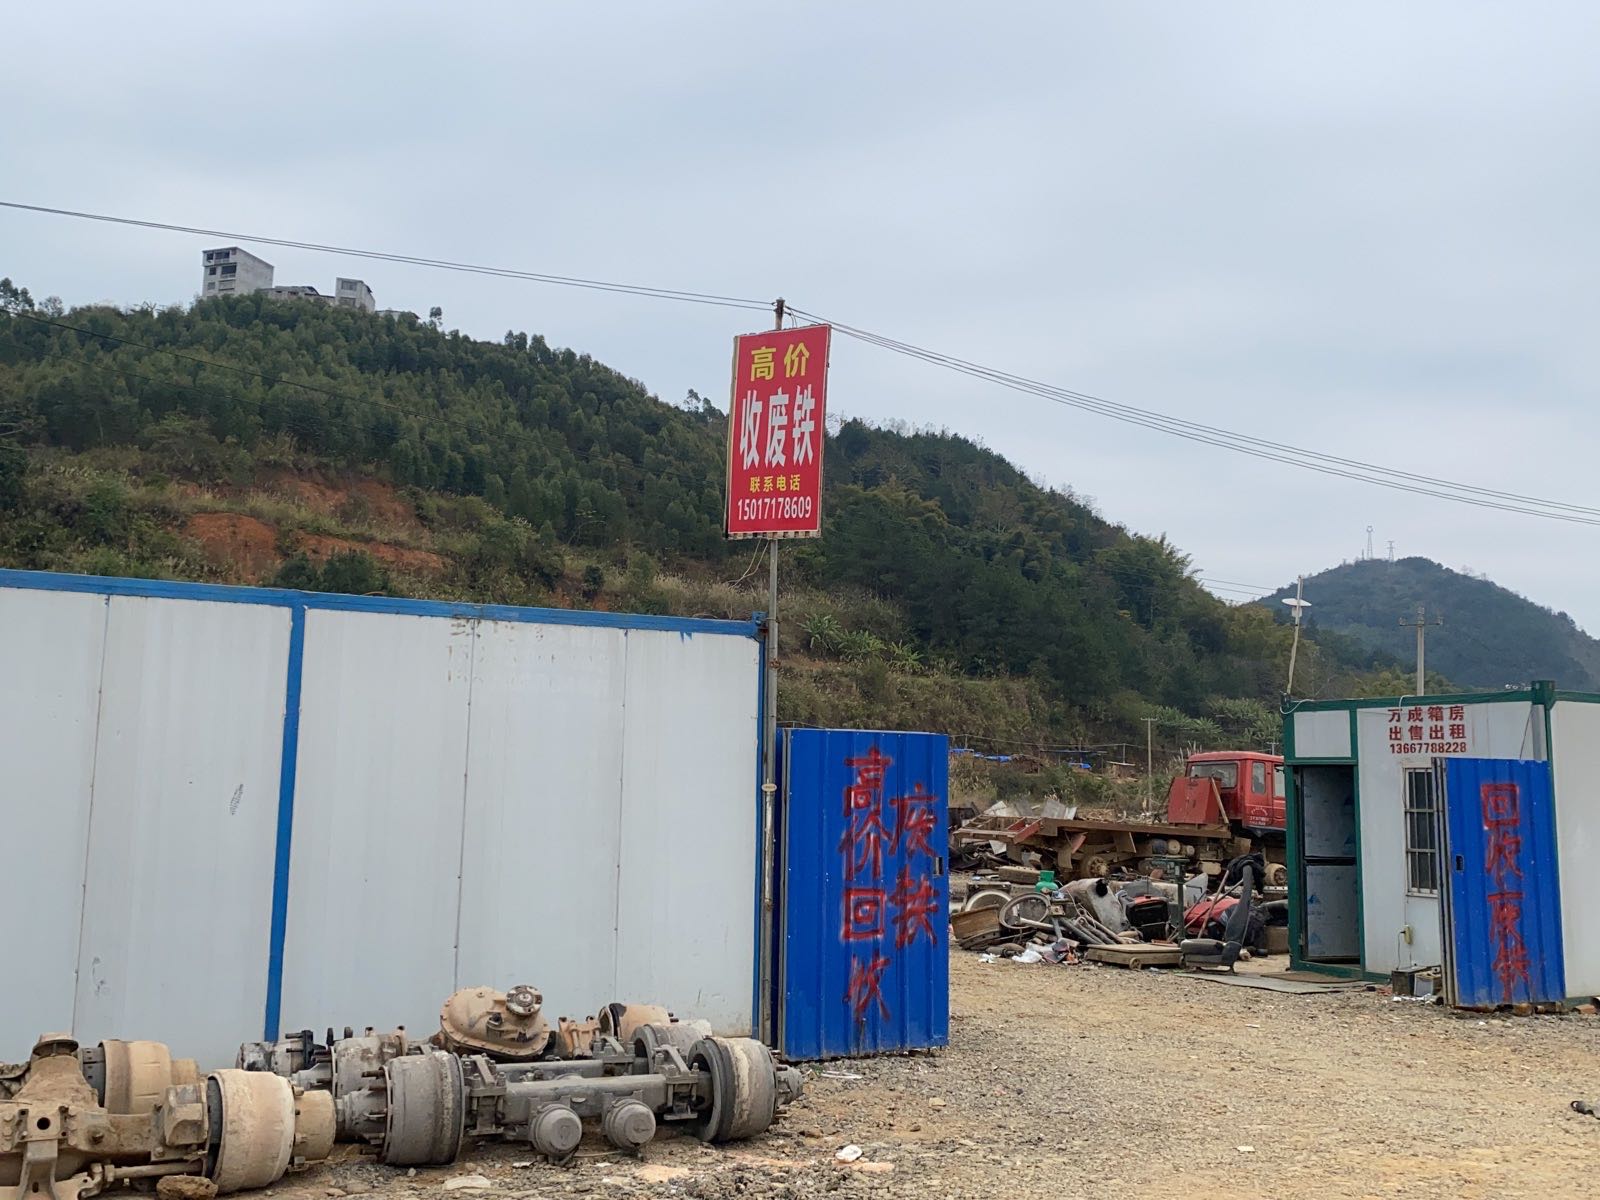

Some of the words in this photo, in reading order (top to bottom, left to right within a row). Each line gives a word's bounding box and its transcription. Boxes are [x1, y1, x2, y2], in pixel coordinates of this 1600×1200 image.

[751, 342, 809, 381] 高价
[740, 384, 815, 470] 收废铁
[749, 474, 801, 493] 联系电话
[737, 496, 812, 521] 15017178609
[1387, 705, 1465, 723] 万成箱房
[1389, 723, 1466, 741] 出售出租
[1390, 742, 1467, 754] 13667788228
[838, 745, 893, 1023] 高价回收
